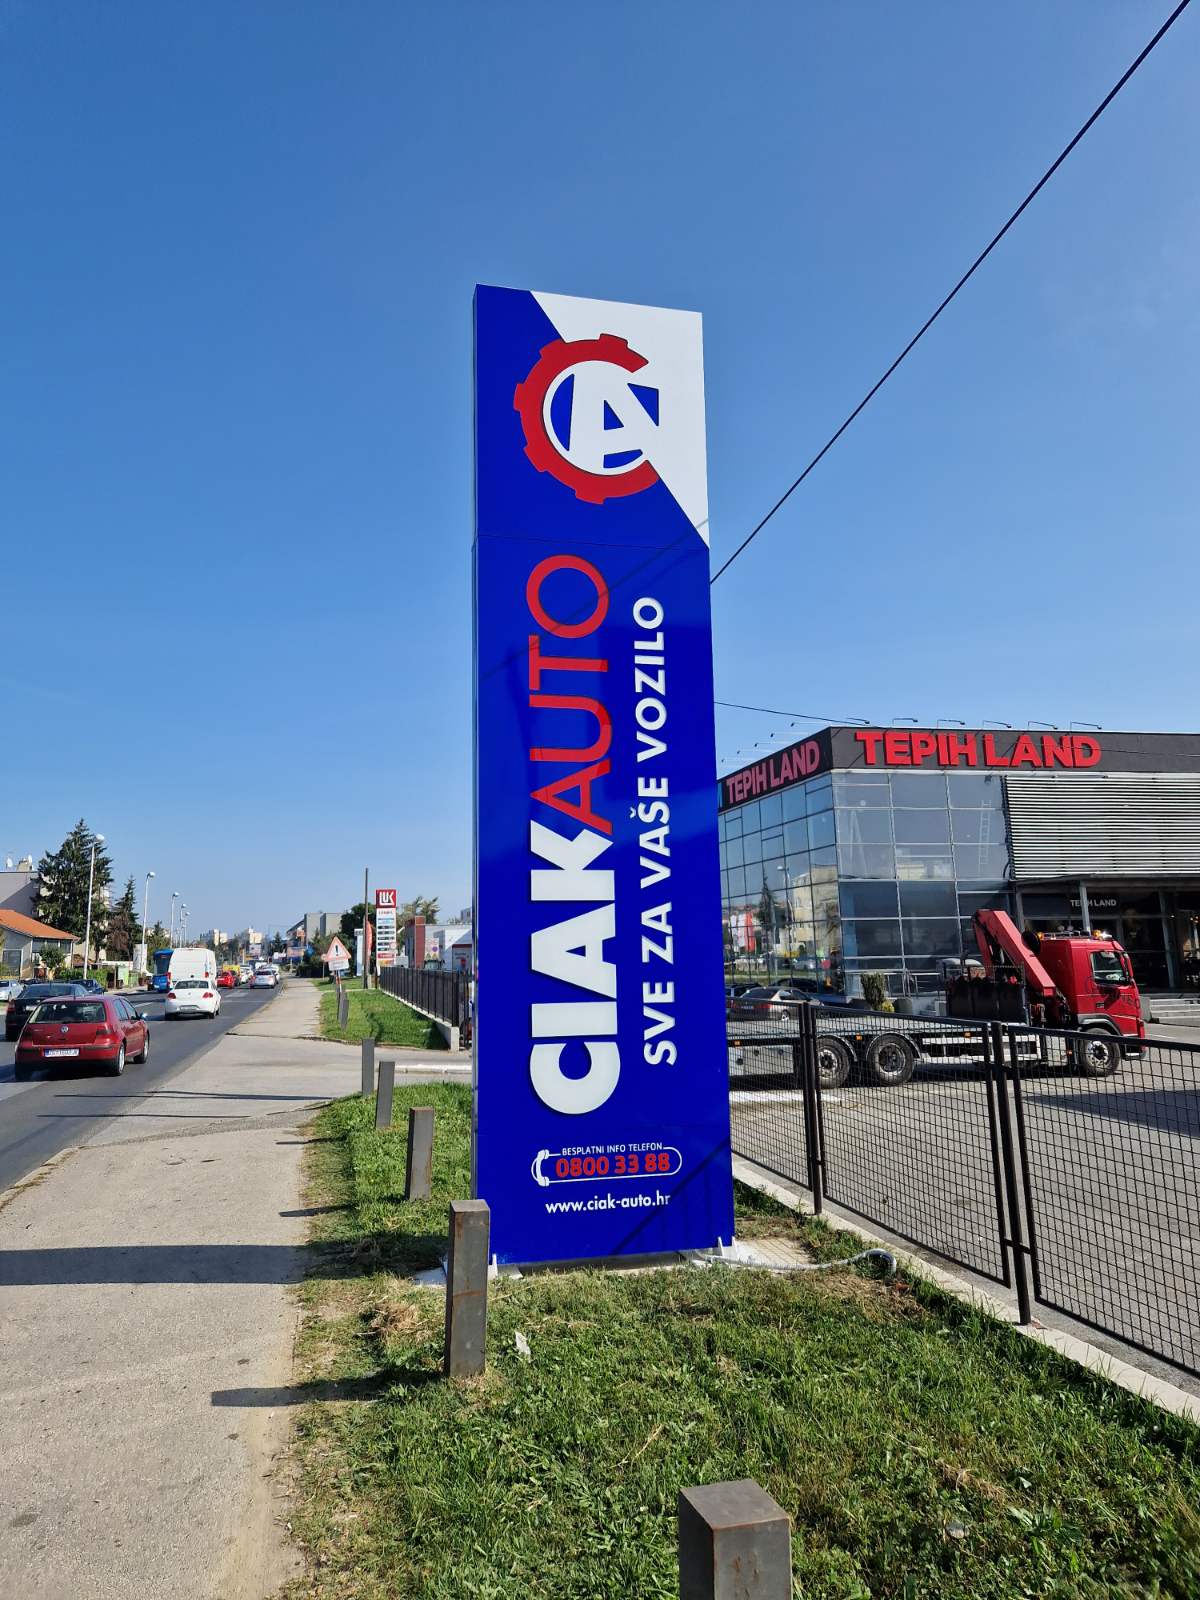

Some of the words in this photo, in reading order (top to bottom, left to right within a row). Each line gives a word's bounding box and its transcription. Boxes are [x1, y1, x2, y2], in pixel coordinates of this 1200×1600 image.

[632, 597, 668, 763] VOZILO
[726, 760, 769, 805] TEPIH
[768, 740, 820, 788] LAND
[856, 729, 978, 768] TEPIH
[982, 733, 1103, 769] LAND
[629, 776, 671, 889] VAŠE
[1094, 898, 1117, 907] LAND
[641, 902, 674, 965] ZA
[643, 981, 678, 1066] SVE
[556, 1157, 609, 1178] 0800
[614, 1155, 639, 1174] 33
[644, 1152, 671, 1172] 88
[562, 1145, 604, 1156] BESPLATNI
[607, 1144, 626, 1154] INFO
[628, 1142, 663, 1152] TELEFON
[545, 1189, 671, 1214] www.ciak-auto.hr
